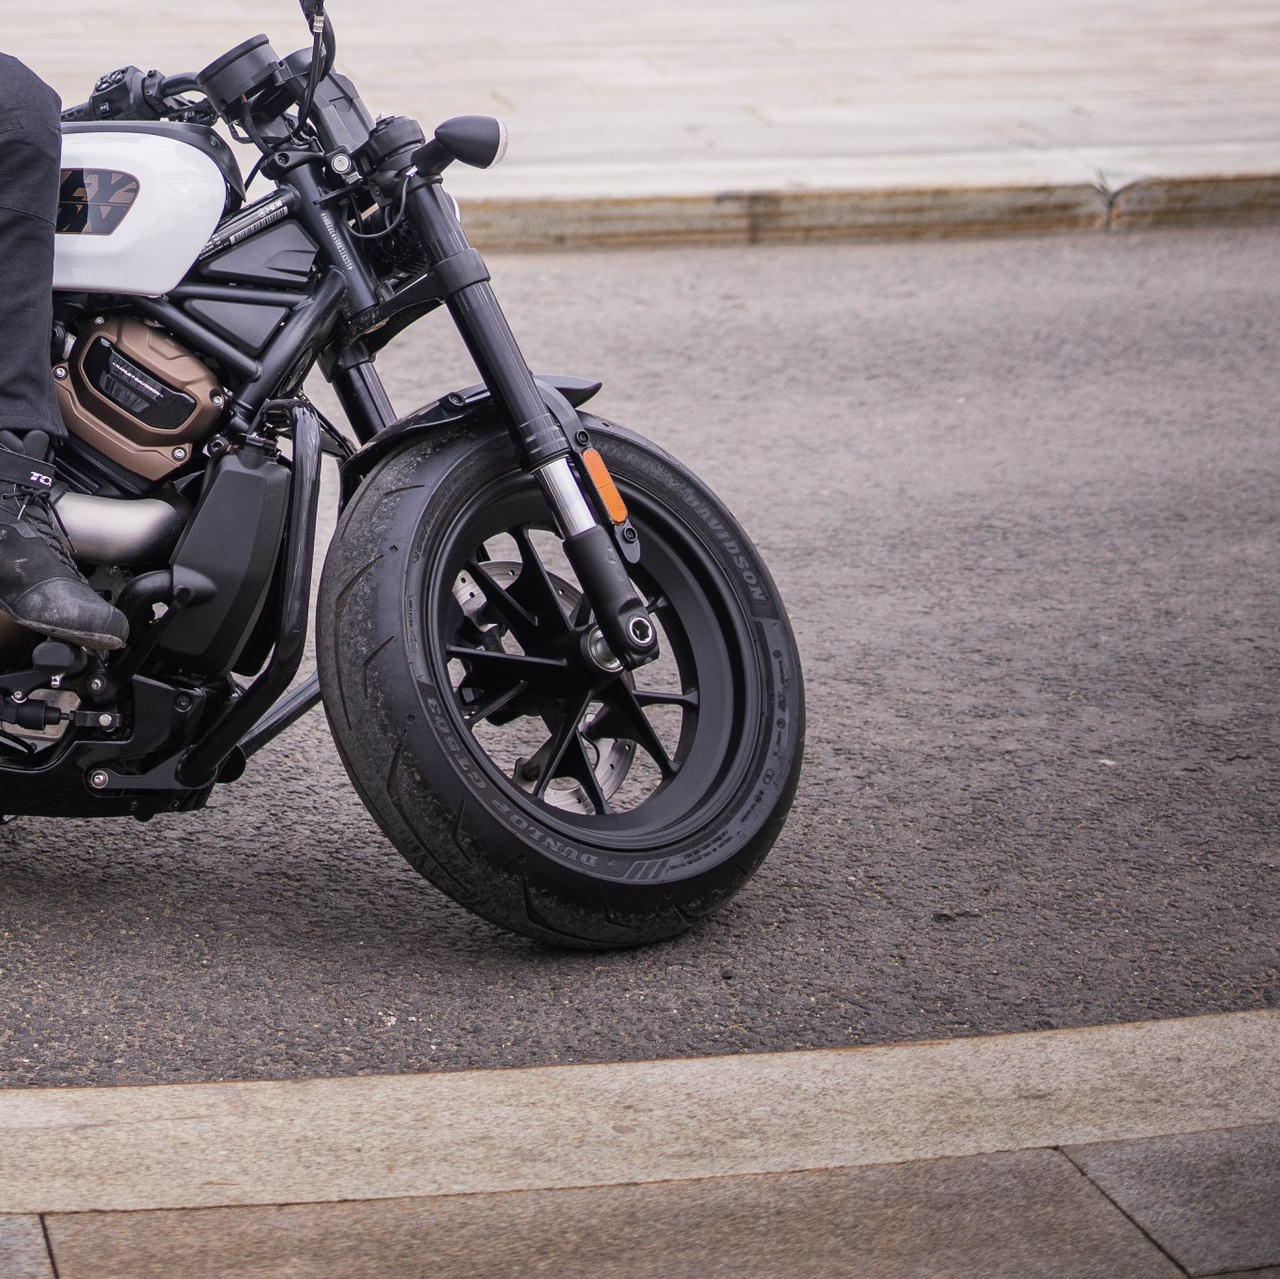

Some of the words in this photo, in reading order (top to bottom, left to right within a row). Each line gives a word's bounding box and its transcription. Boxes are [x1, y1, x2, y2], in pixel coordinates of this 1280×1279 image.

[30, 471, 52, 487] TC
[426, 696, 487, 790] GT503
[491, 798, 600, 868] DUNLOP
